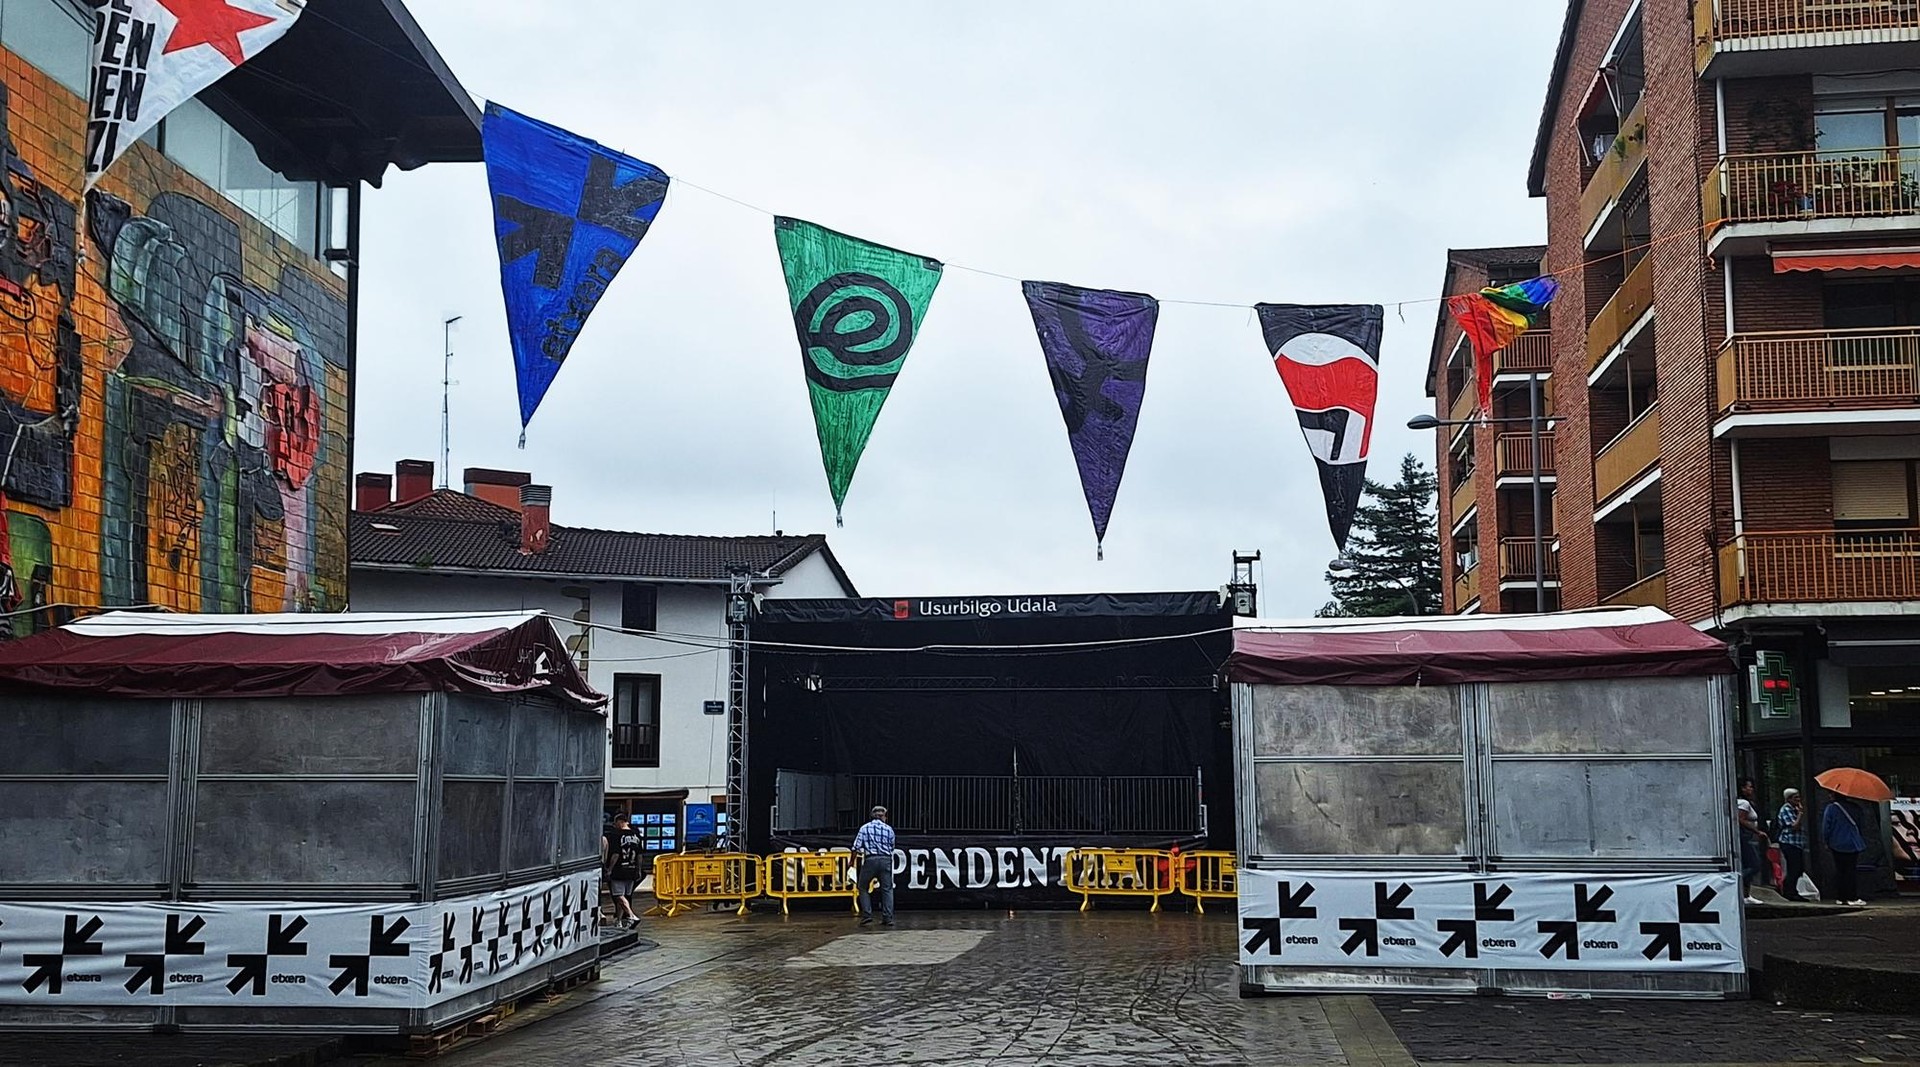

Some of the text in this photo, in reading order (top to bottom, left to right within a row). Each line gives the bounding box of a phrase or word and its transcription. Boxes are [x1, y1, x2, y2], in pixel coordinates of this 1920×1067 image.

[90, 66, 146, 122] EN
[919, 597, 1057, 618] Usurbilgo Udala
[784, 846, 1144, 890] IPENDENTZ
[1285, 934, 1319, 945] etxera
[1382, 935, 1417, 947] etxera
[1481, 937, 1517, 949] etxera
[1583, 939, 1619, 950] etxera
[1686, 940, 1723, 951] etxera
[66, 973, 102, 983] etxera
[169, 972, 204, 983] etxera
[271, 973, 306, 984] etxera
[373, 974, 409, 985] etxera
